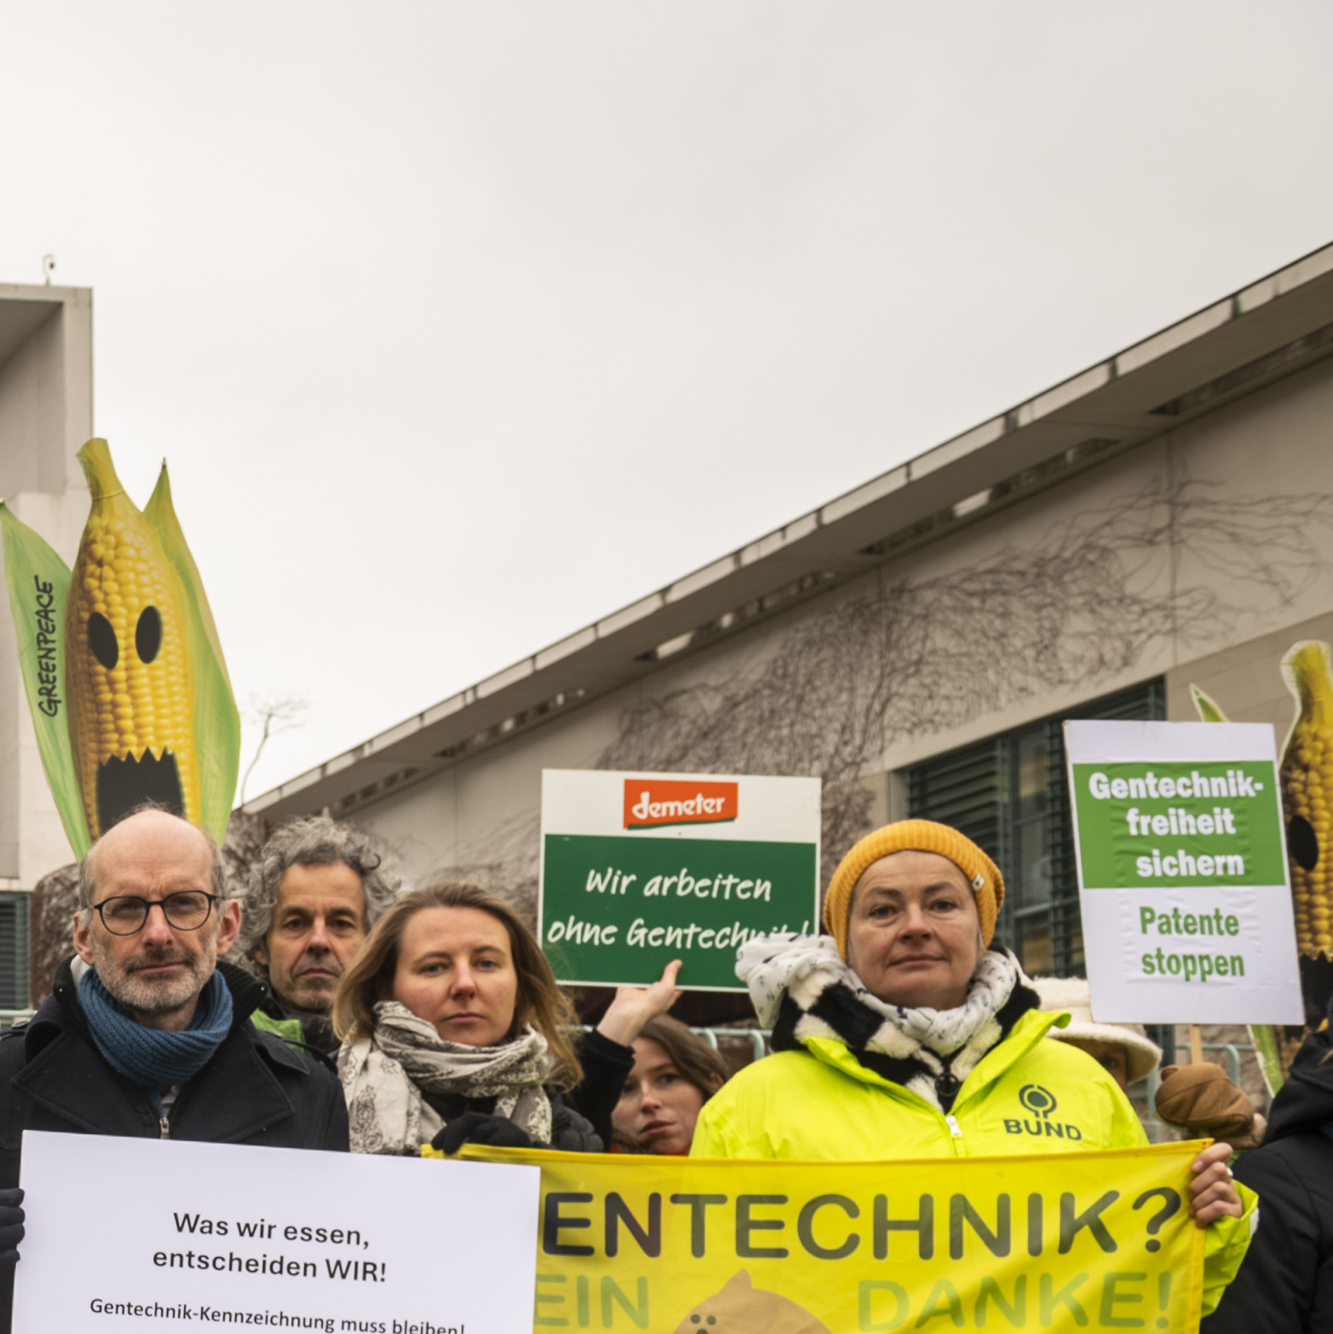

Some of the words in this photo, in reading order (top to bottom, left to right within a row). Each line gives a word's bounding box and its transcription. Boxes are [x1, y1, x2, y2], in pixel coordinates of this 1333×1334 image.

[34, 575, 61, 717] GREENPEACE
[1089, 771, 1264, 800] Gentechnik-
[632, 791, 726, 821] demeter
[1127, 807, 1236, 836] freiheit
[1136, 849, 1245, 877] sichern
[586, 868, 637, 898] Wir
[644, 868, 773, 902] arbeiten
[547, 915, 618, 945] ohne
[1140, 907, 1240, 936] Patente
[1141, 947, 1245, 983] stoppen
[1003, 1119, 1082, 1141] BUND
[173, 1212, 229, 1236] Was
[236, 1218, 277, 1239] wir
[283, 1225, 370, 1251] essen,
[543, 1187, 1182, 1260] ENTECHNIK?
[152, 1250, 318, 1278] entscheiden
[325, 1259, 387, 1283] WIR!
[90, 1298, 335, 1334] Gentechnik-Kennzeichnung
[340, 1321, 387, 1334] muss
[534, 1273, 651, 1329] EIN
[858, 1271, 1172, 1332] DANKE!
